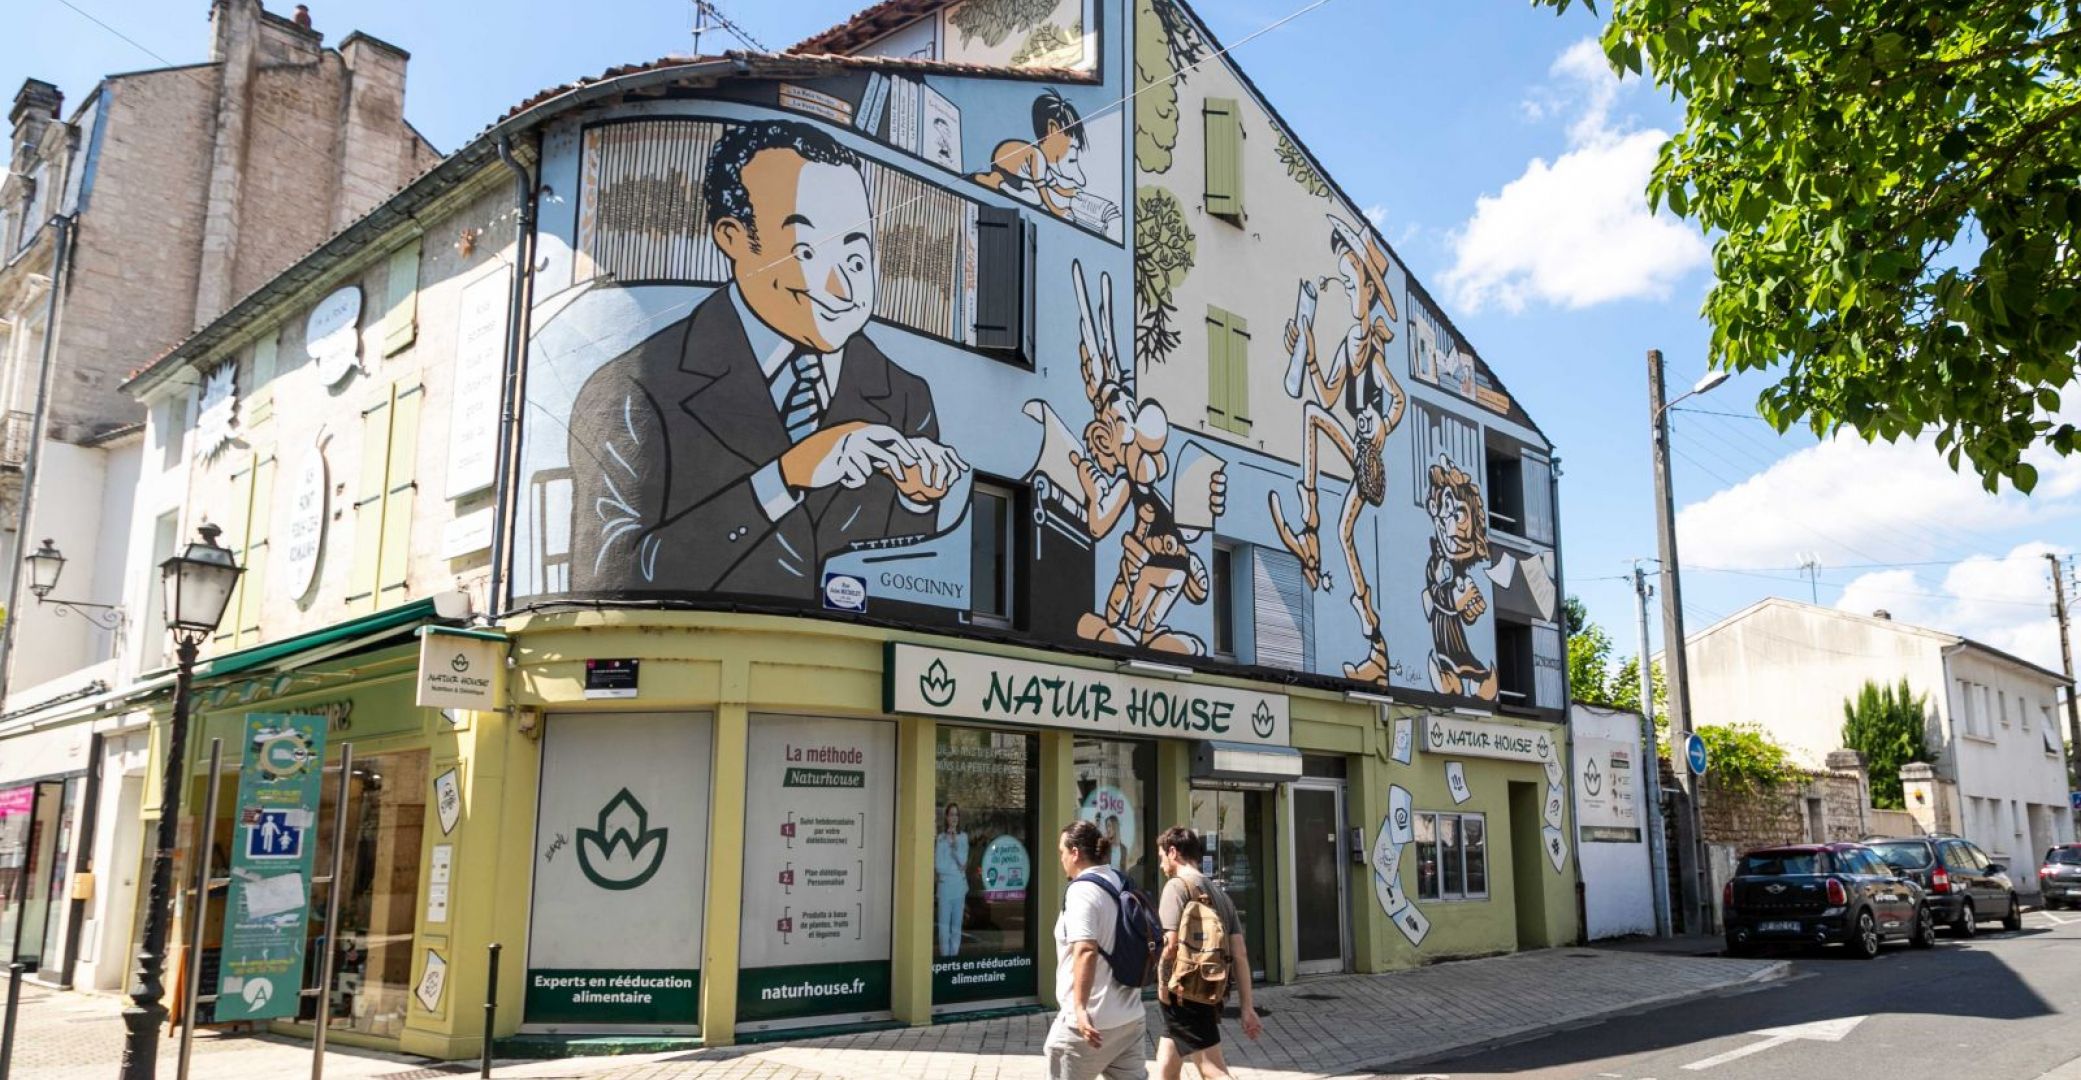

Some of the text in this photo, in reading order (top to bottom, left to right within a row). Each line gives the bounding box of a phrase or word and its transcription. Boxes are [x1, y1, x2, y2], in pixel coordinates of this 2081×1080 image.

[880, 572, 964, 599] GOSCINNY
[428, 673, 490, 687] NATUR HOUSE
[982, 670, 1235, 733] NATUR HOUSE
[1446, 728, 1534, 753] NATUR HOUSE
[786, 744, 863, 764] La méthode
[791, 770, 860, 786] Naturhouse
[825, 827, 840, 835] votre
[963, 961, 975, 970] en
[976, 955, 1031, 970] rééducation
[534, 974, 692, 990] Experts en rééducation
[951, 971, 1007, 985] alimentaire
[572, 990, 652, 1003] alimentaire
[761, 978, 865, 1000] naturhouse.fr
